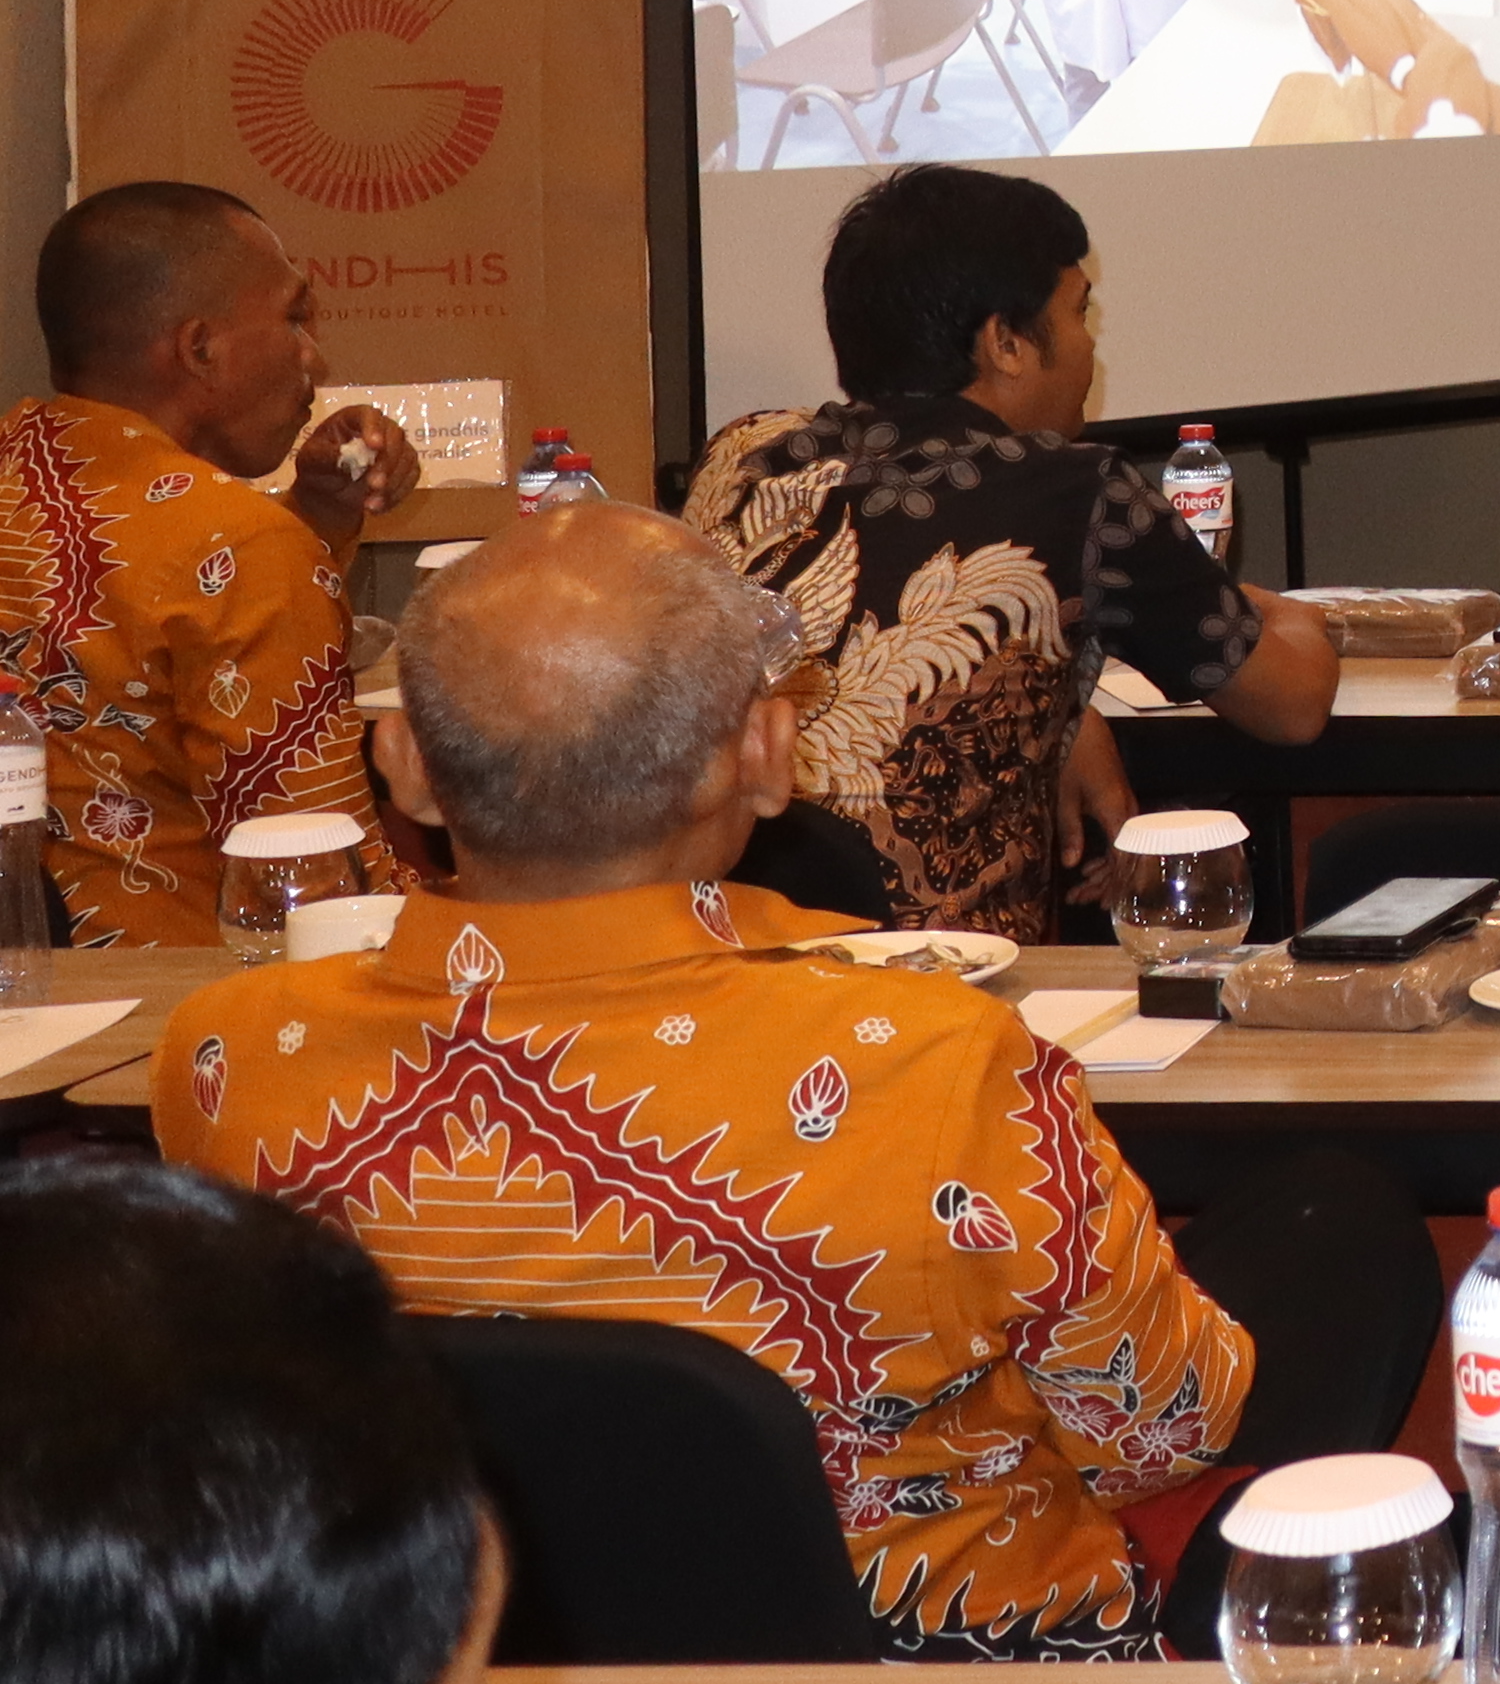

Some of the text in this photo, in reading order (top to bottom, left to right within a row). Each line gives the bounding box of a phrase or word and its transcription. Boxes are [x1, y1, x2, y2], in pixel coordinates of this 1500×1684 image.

[288, 252, 508, 290] NDHIS
[313, 304, 513, 321] OUTIQUE HOTEL
[1173, 493, 1221, 510] cheers
